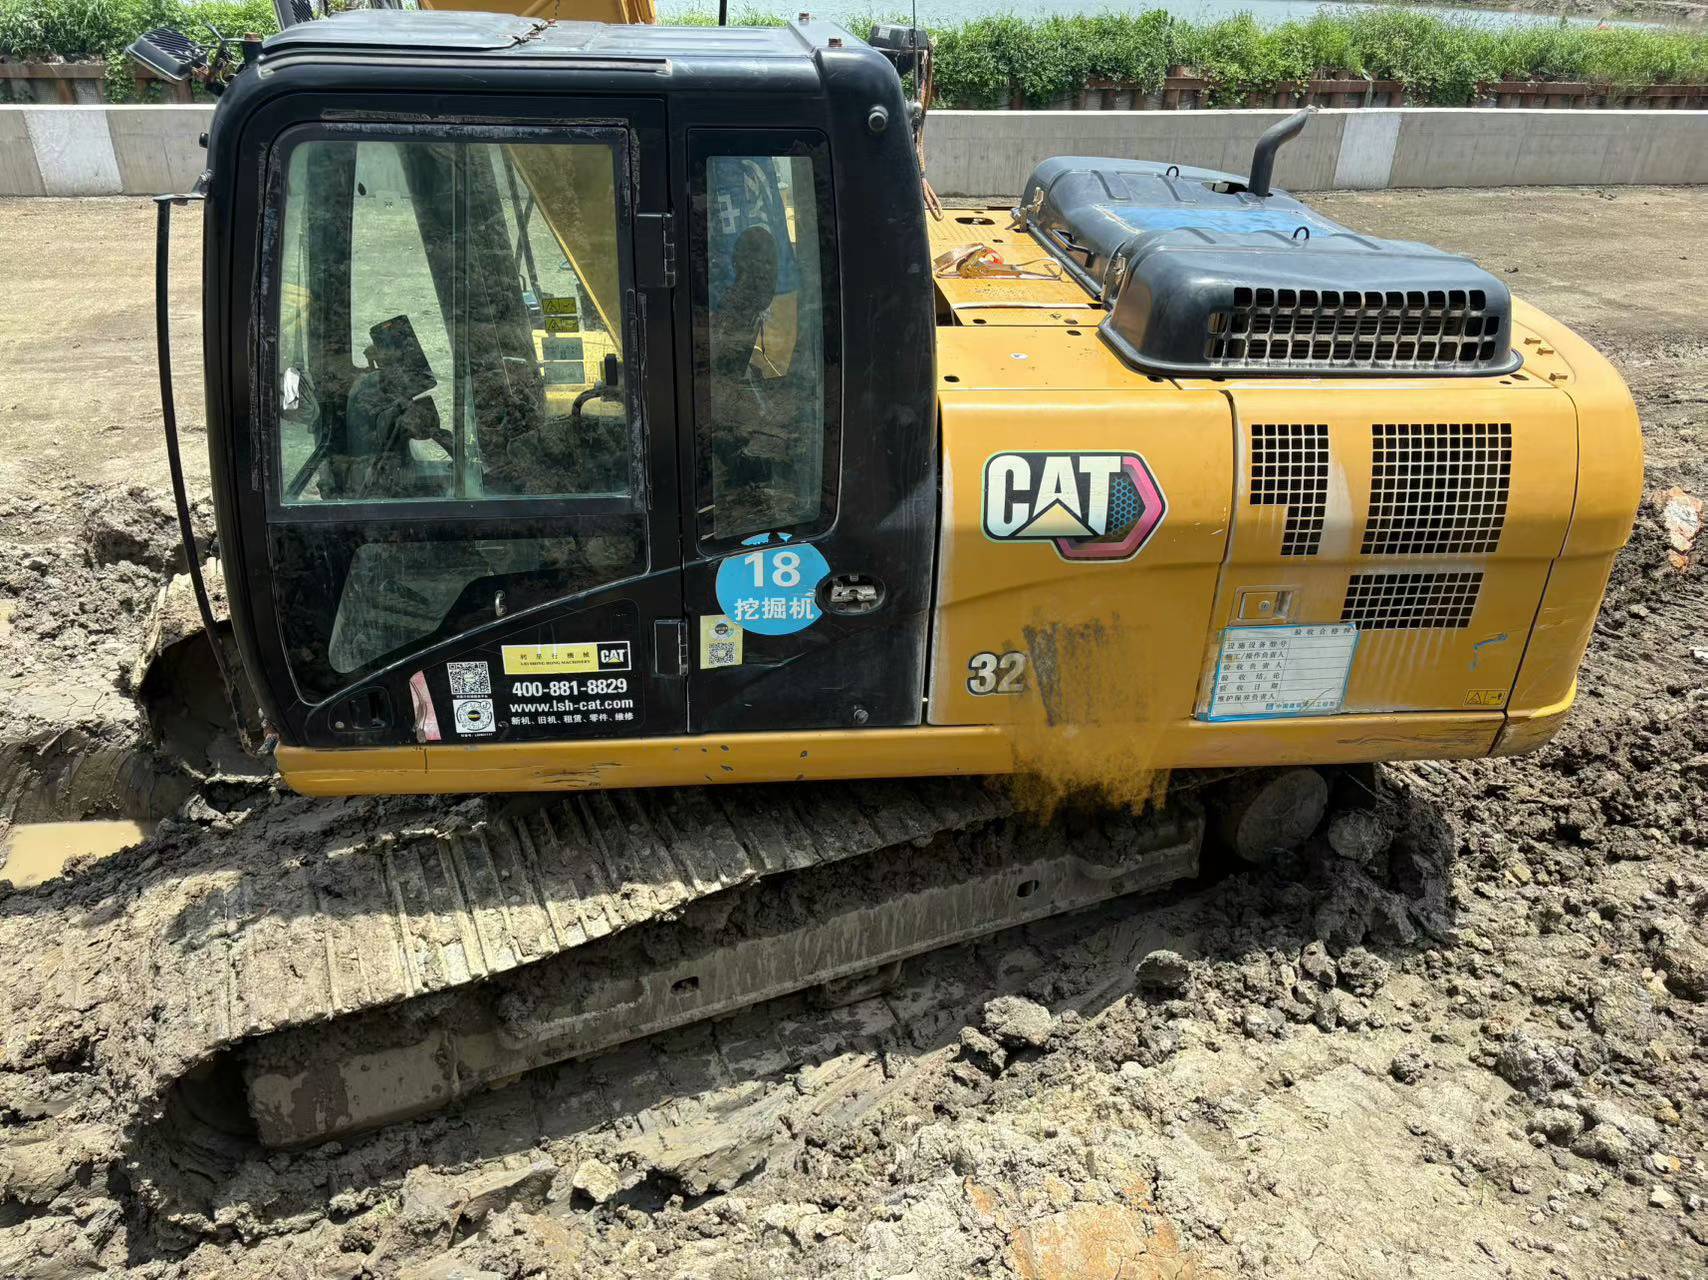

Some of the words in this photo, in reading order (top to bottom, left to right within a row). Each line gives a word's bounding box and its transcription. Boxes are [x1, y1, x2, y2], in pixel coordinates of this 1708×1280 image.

[986, 455, 1121, 536] CAT
[744, 551, 801, 587] 18
[734, 597, 815, 621] 挖掘机
[600, 649, 625, 664] CAT
[512, 678, 628, 697] 400-881-8829
[509, 699, 634, 713] www.lsh-cat.com
[511, 712, 634, 726] 新机、旧机、租赁、零件、维修
